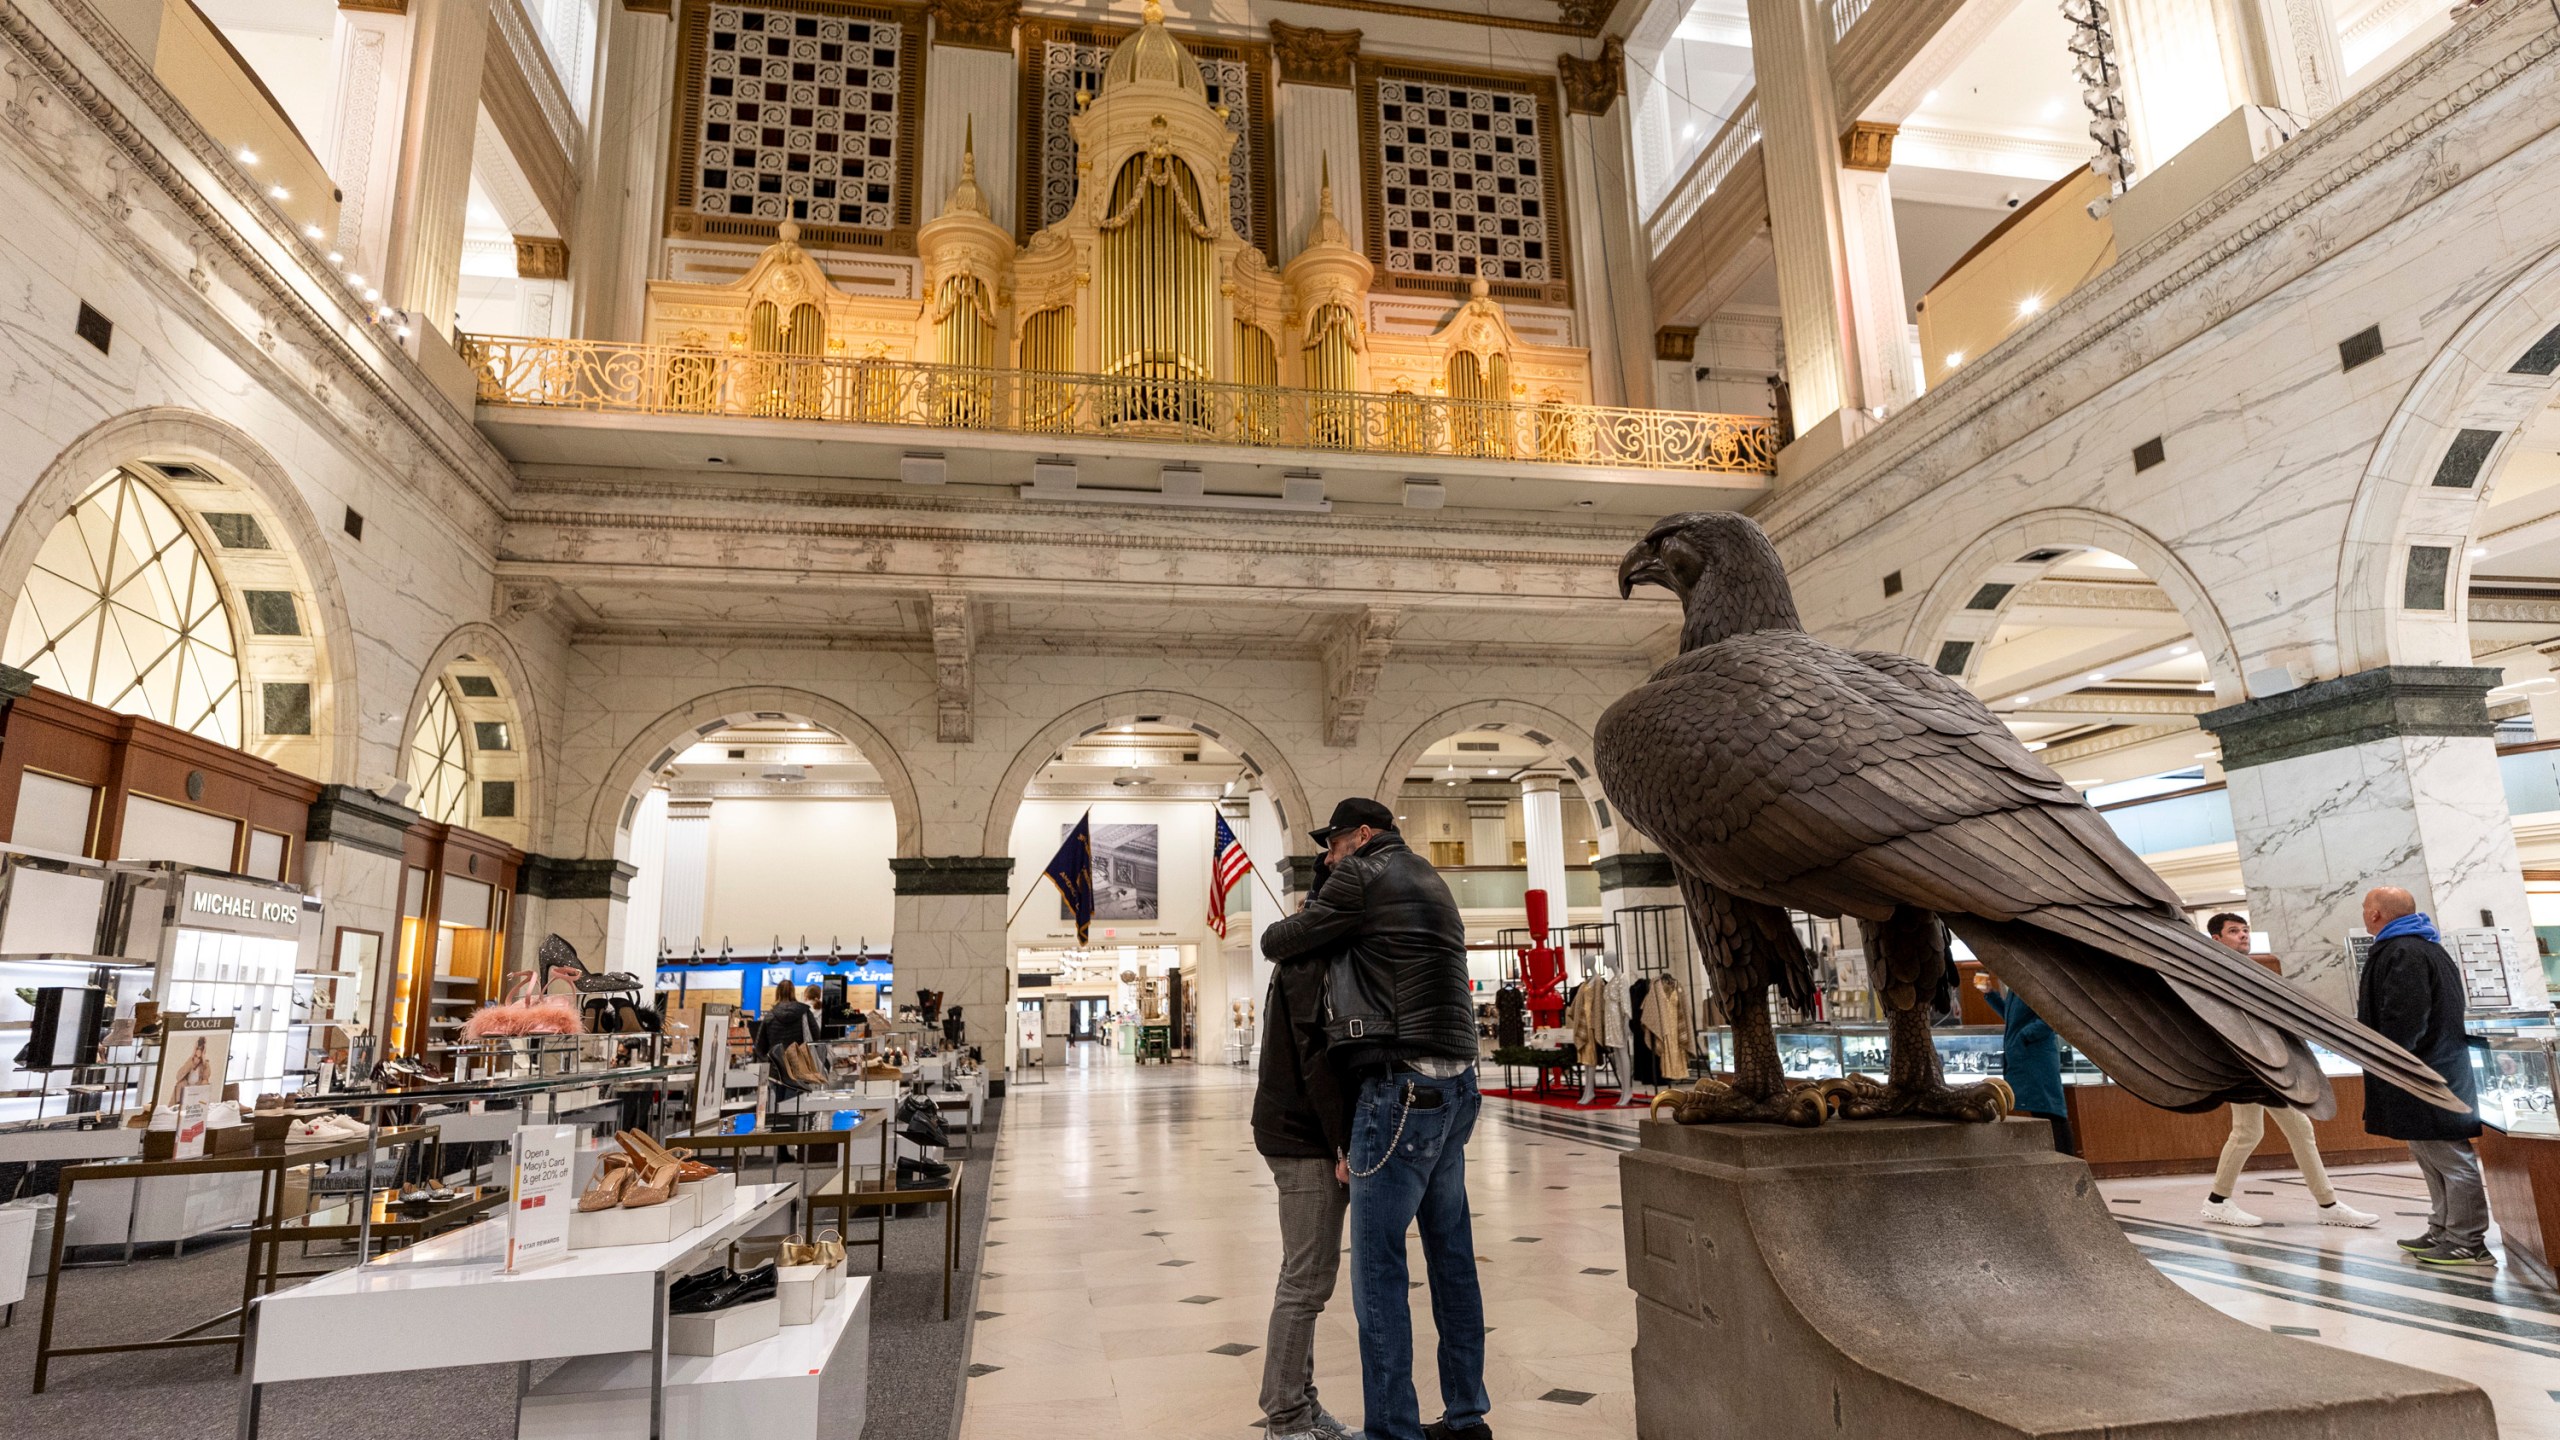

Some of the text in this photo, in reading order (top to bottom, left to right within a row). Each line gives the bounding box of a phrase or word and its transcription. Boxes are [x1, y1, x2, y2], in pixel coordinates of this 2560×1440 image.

[193, 891, 298, 924] MICHAEL KORS
[184, 1019, 221, 1029] COACH
[353, 1037, 376, 1047] DKNY
[524, 1149, 543, 1160] Open
[523, 1157, 565, 1171] Macy's Card
[522, 1168, 568, 1185] & get 20% off
[523, 1242, 535, 1250] STAR
